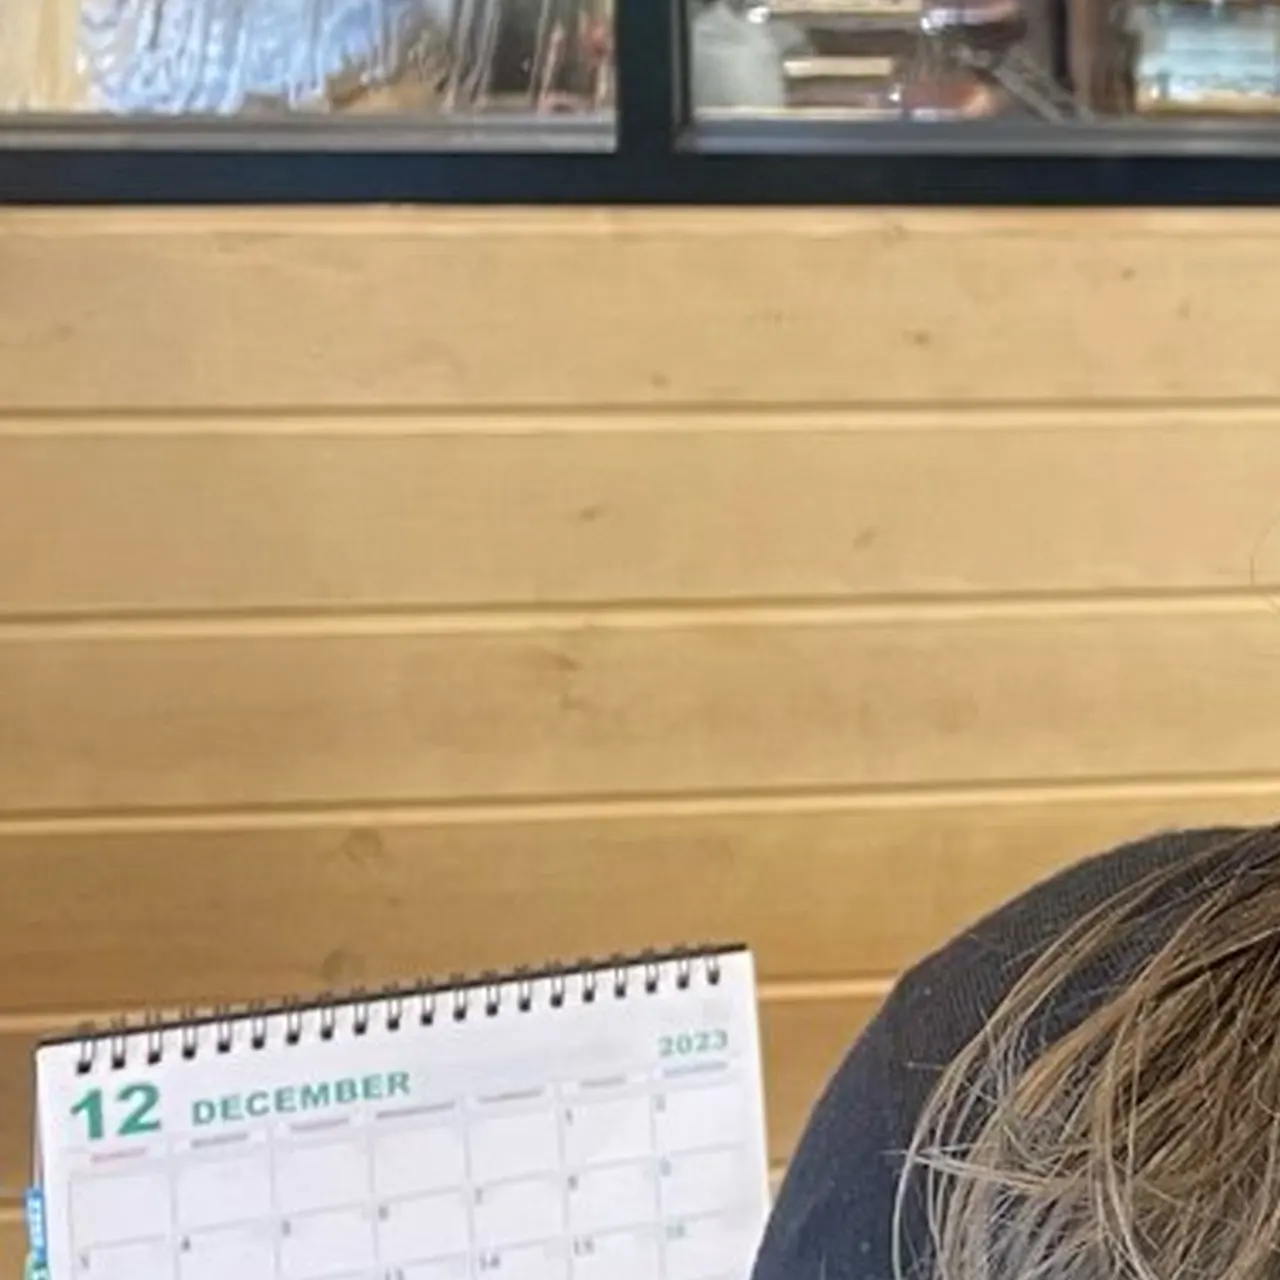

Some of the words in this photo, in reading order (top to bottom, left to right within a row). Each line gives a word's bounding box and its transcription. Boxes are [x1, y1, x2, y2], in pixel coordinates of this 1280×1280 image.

[658, 1030, 729, 1057] 2023
[70, 1082, 162, 1141] 12
[191, 1070, 411, 1127] DECEMBER
